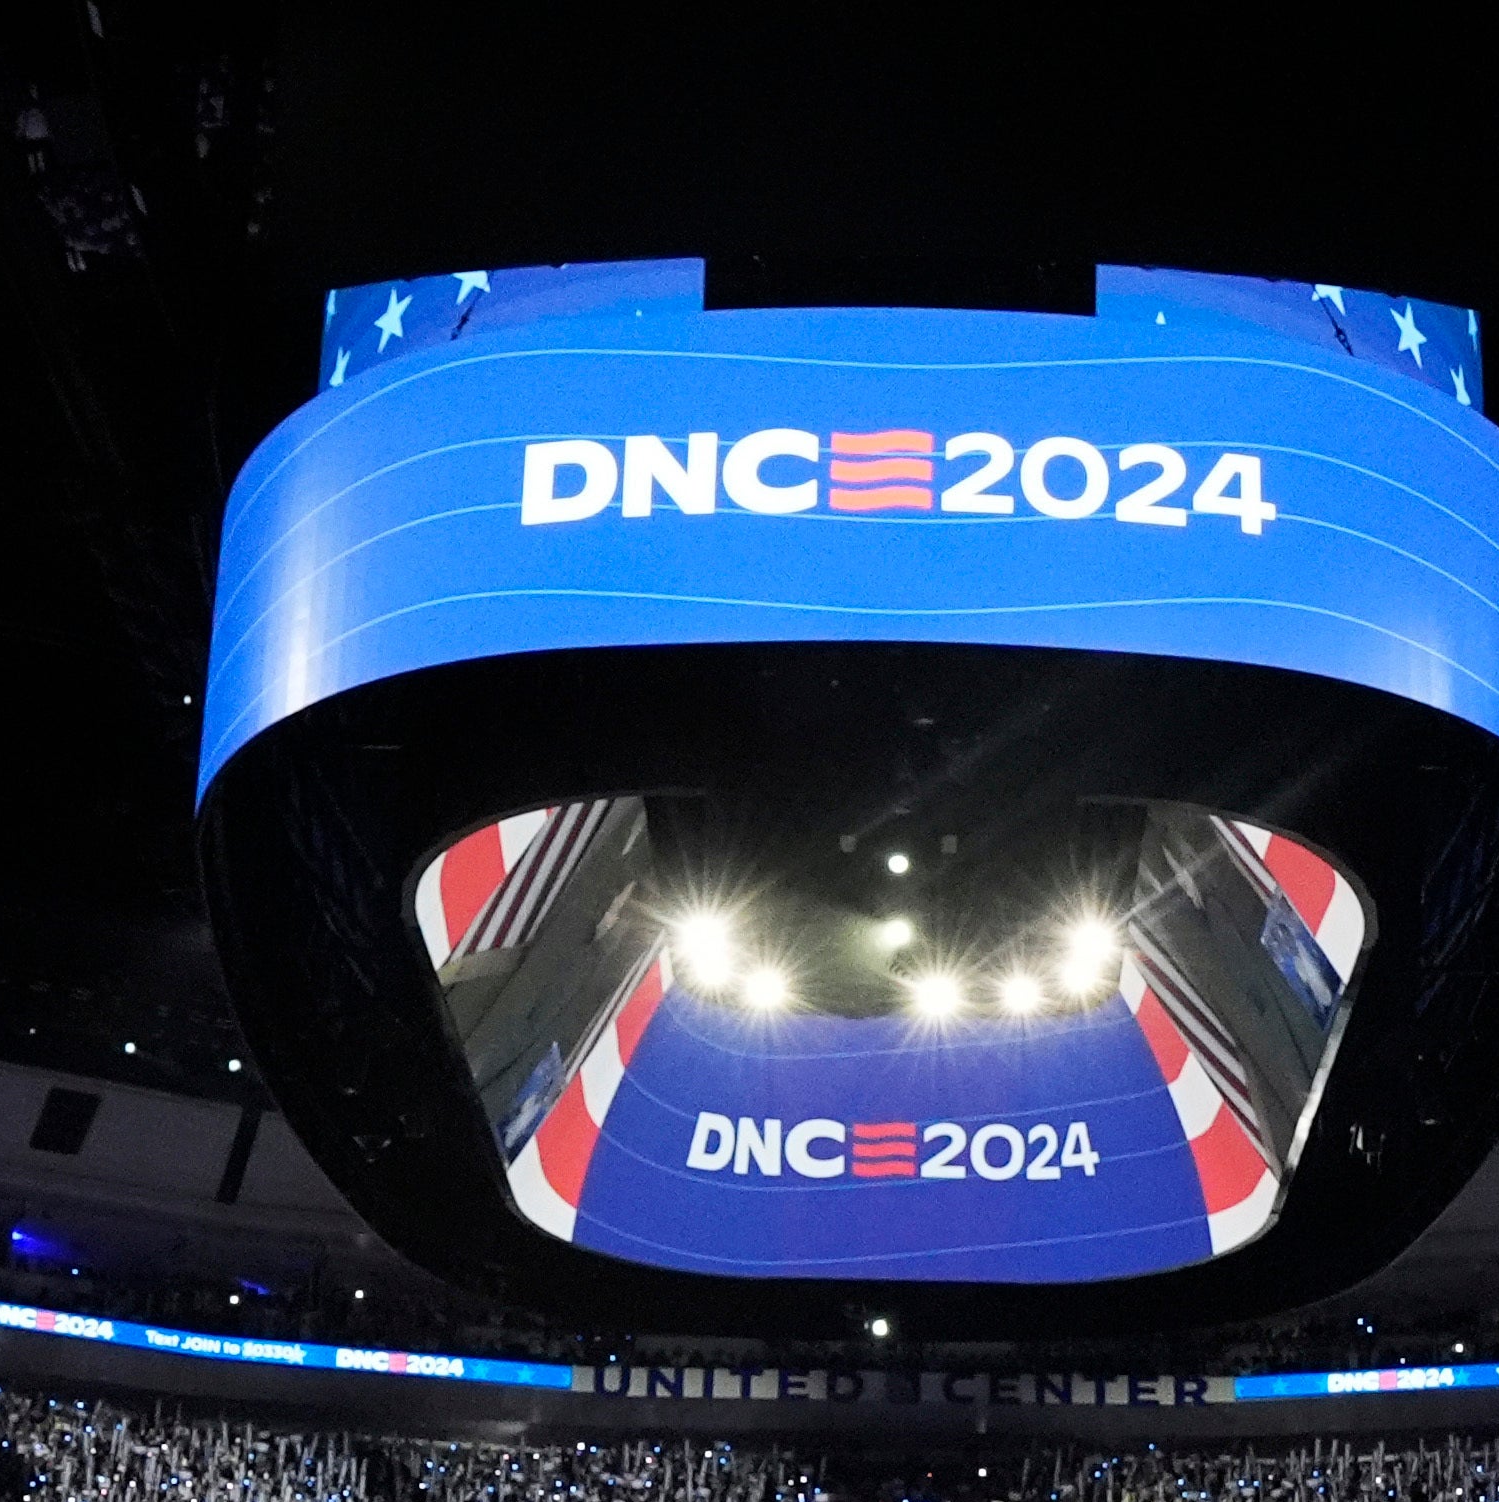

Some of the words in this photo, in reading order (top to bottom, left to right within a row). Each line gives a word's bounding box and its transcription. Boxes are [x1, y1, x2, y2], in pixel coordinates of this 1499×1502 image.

[521, 428, 820, 526] DNC
[940, 432, 1277, 535] 2024
[686, 1112, 846, 1178] DNC
[920, 1122, 1099, 1181] 2024
[53, 1313, 114, 1340] 2024
[336, 1348, 389, 1372] DNC
[405, 1354, 465, 1377] 2024
[595, 1365, 863, 1401] UNITED
[941, 1370, 1210, 1405] CENTER
[1327, 1371, 1380, 1393] DNC
[1395, 1367, 1455, 1390] 2024
